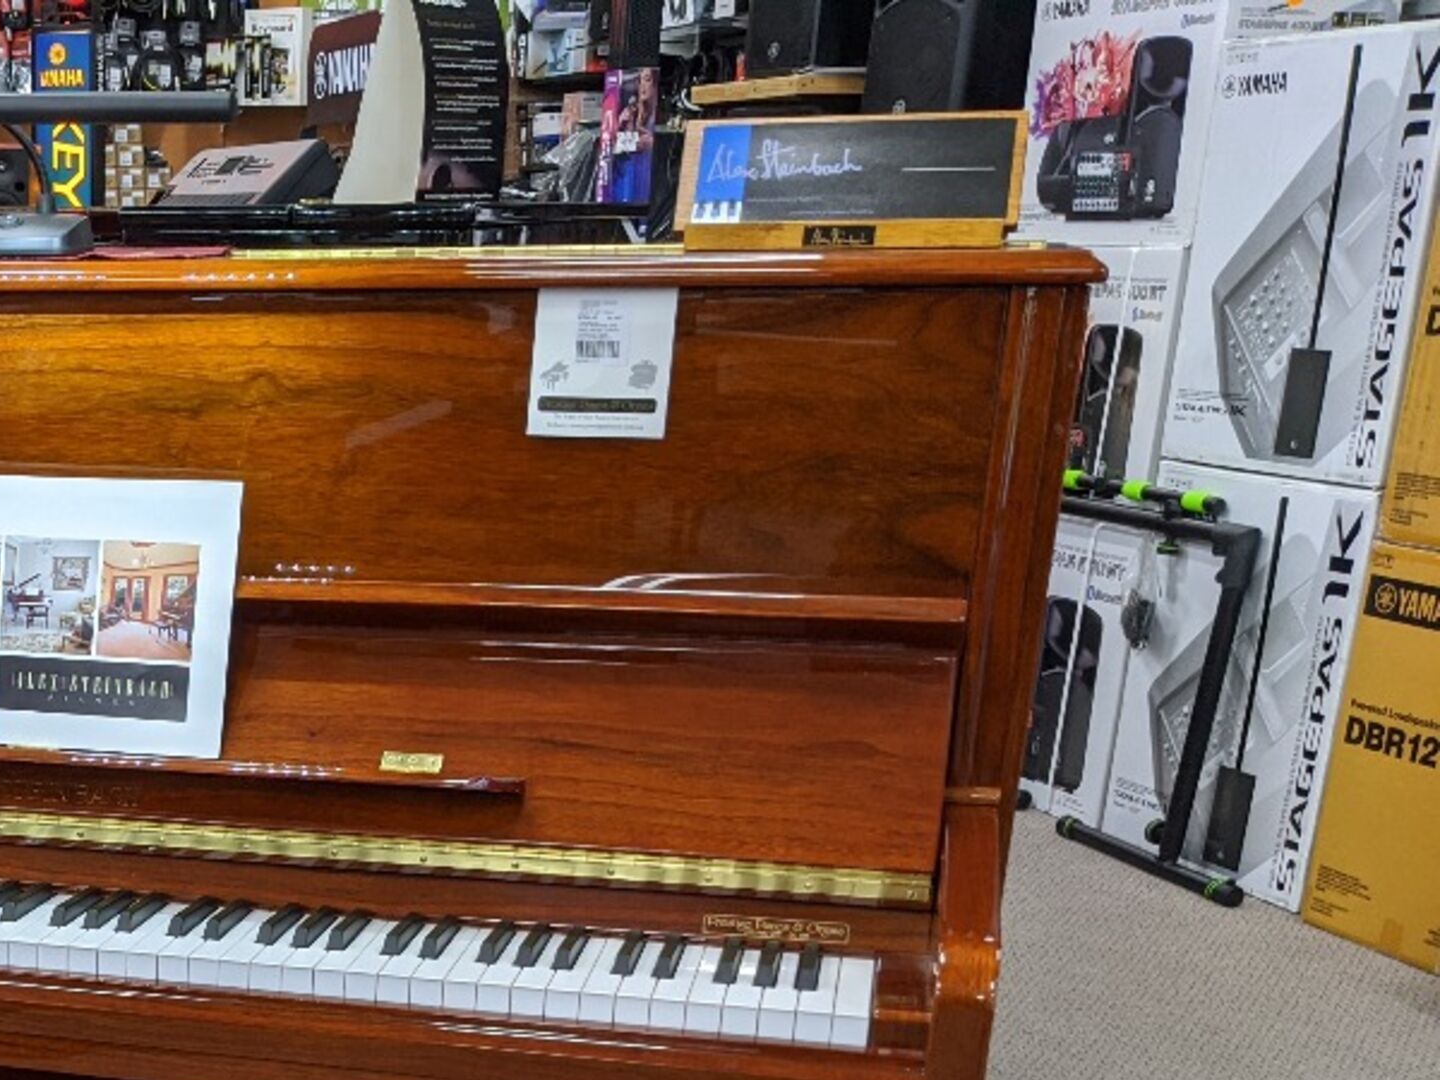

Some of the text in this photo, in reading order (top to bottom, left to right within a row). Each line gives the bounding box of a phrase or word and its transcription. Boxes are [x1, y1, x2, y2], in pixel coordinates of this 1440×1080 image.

[39, 69, 85, 88] YAMAHA
[1236, 70, 1288, 98] YAMAHA
[707, 138, 863, 183] Alex Steinbach
[1355, 157, 1426, 469] STAGEPAS
[1400, 44, 1440, 148] 1K
[1275, 615, 1344, 895] STAGEPAS
[1322, 510, 1364, 604] 1K
[1344, 714, 1440, 769] DBR12
